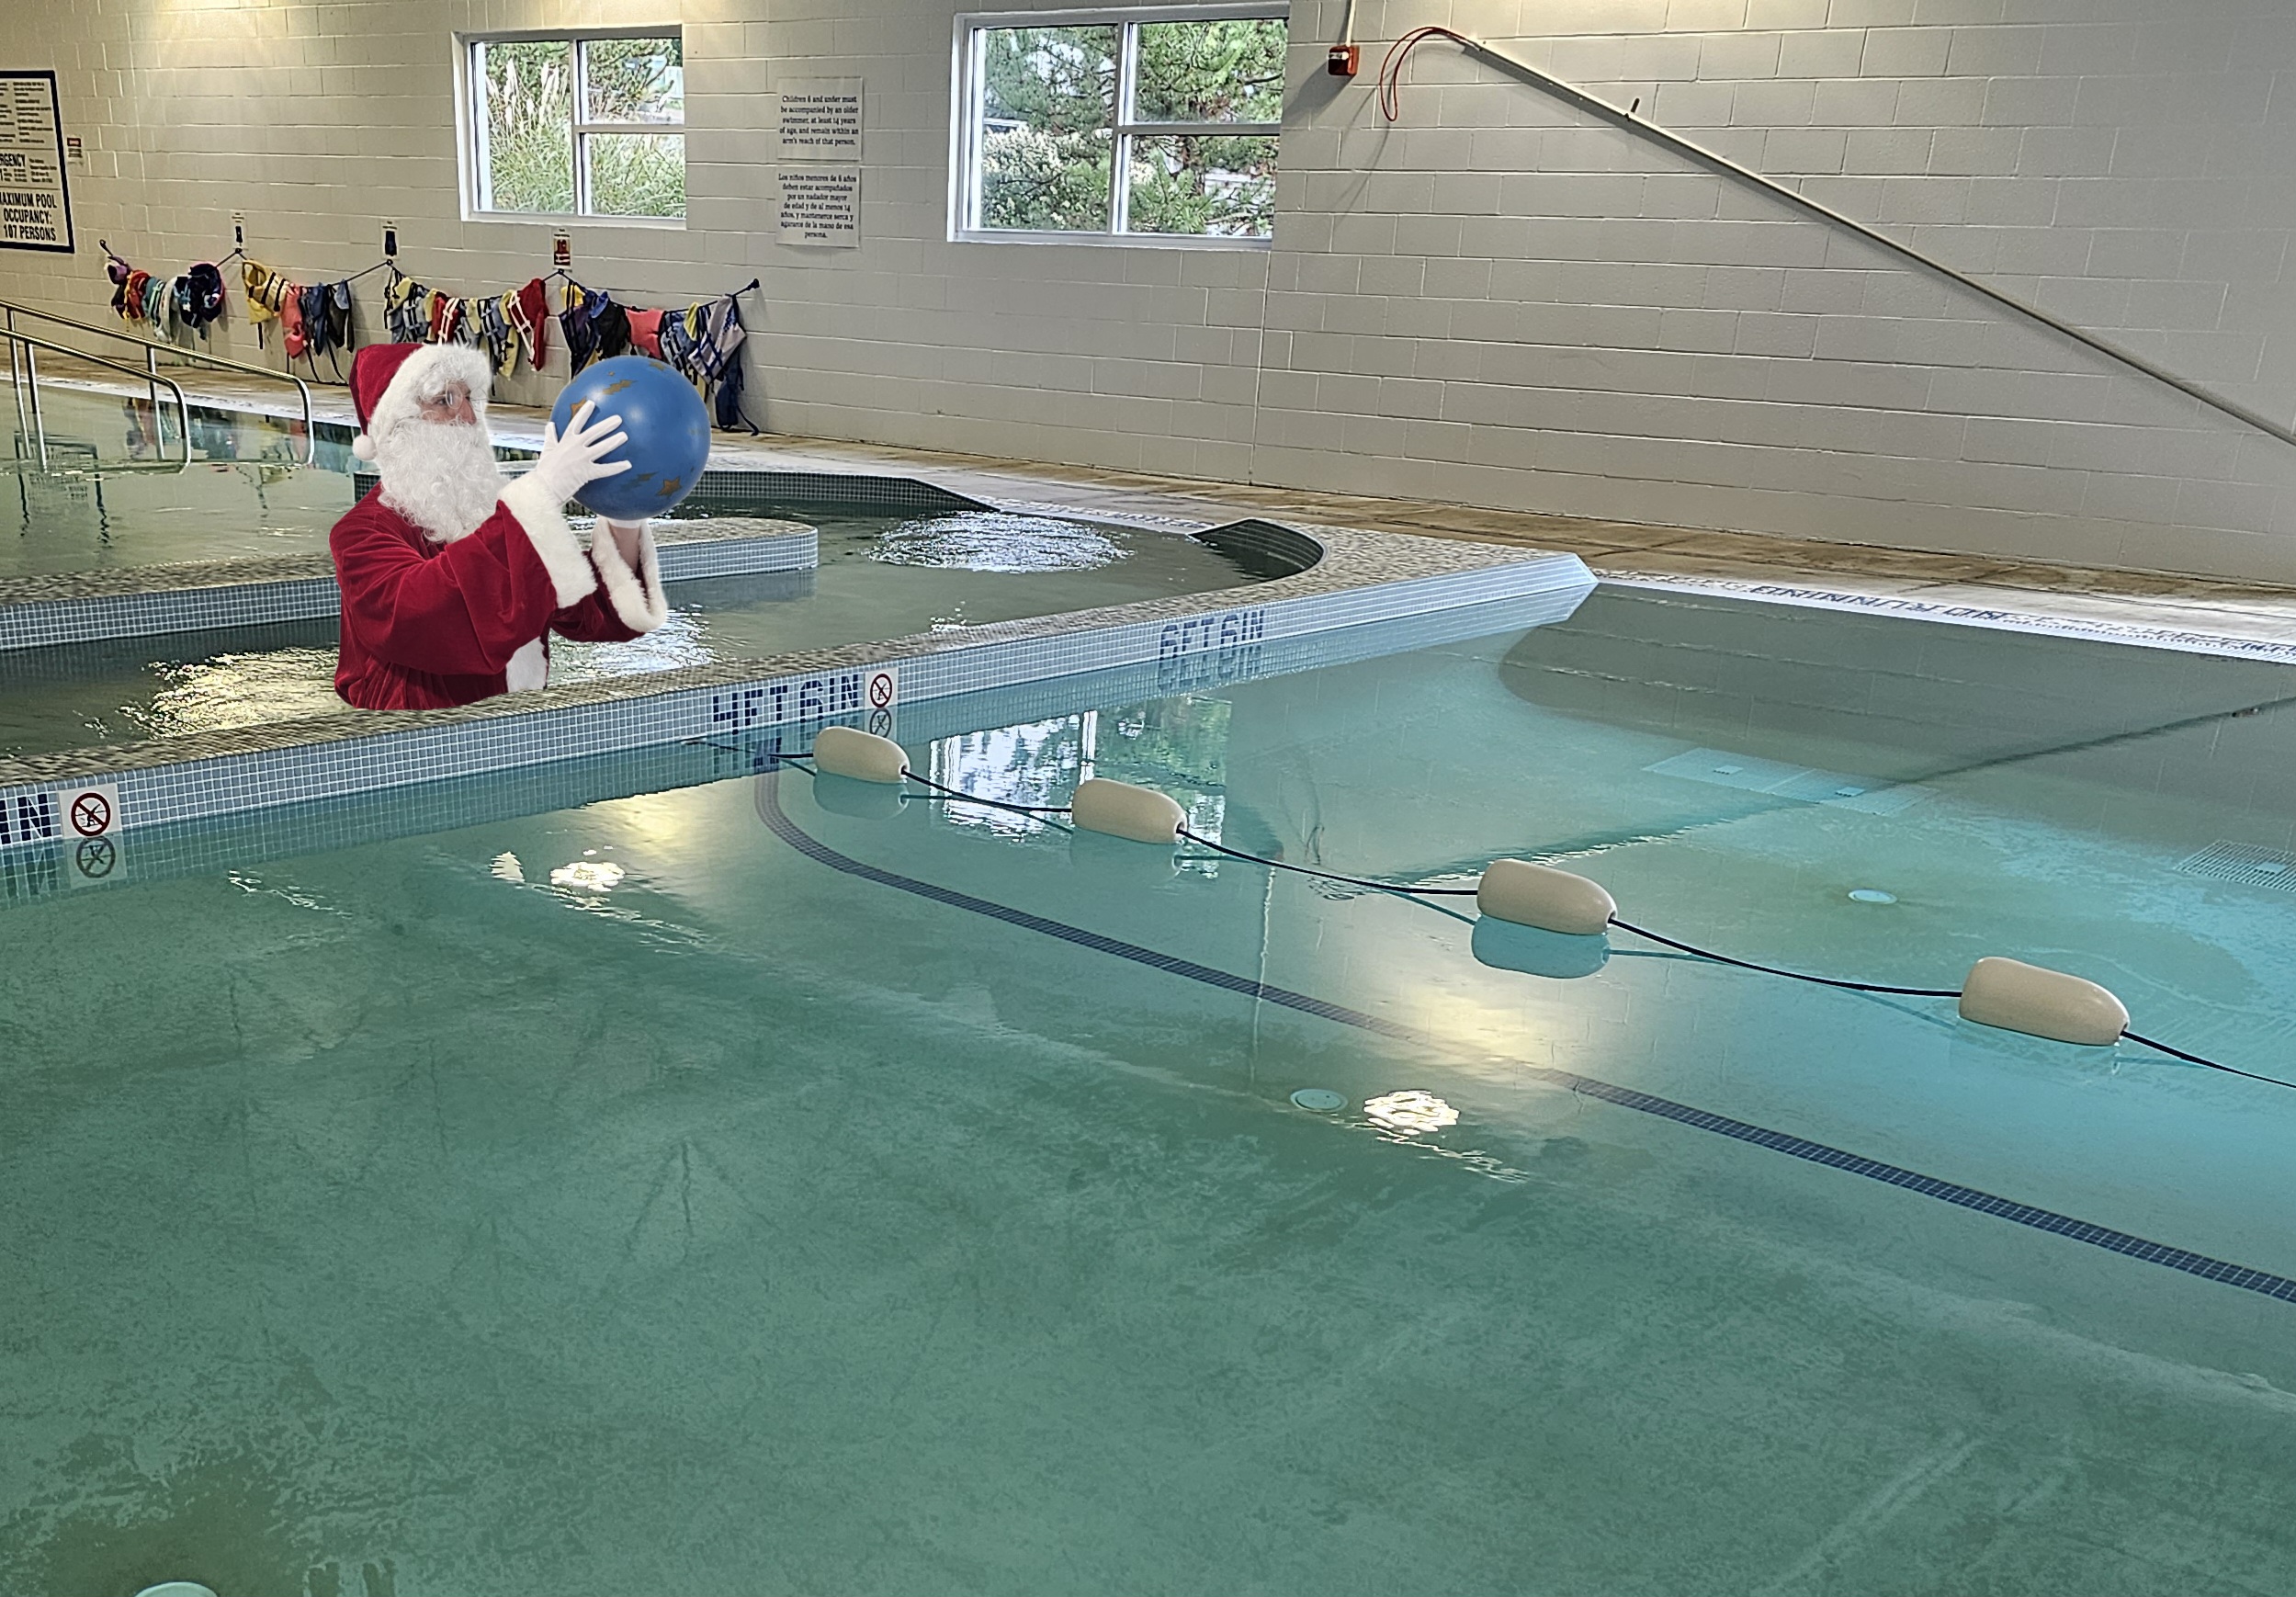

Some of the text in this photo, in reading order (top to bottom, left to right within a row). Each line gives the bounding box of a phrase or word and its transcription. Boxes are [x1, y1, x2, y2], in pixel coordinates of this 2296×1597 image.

[35, 193, 58, 209] POOL
[3, 208, 53, 225] OCCUPANCY:
[3, 223, 57, 242] 107 PERSONS
